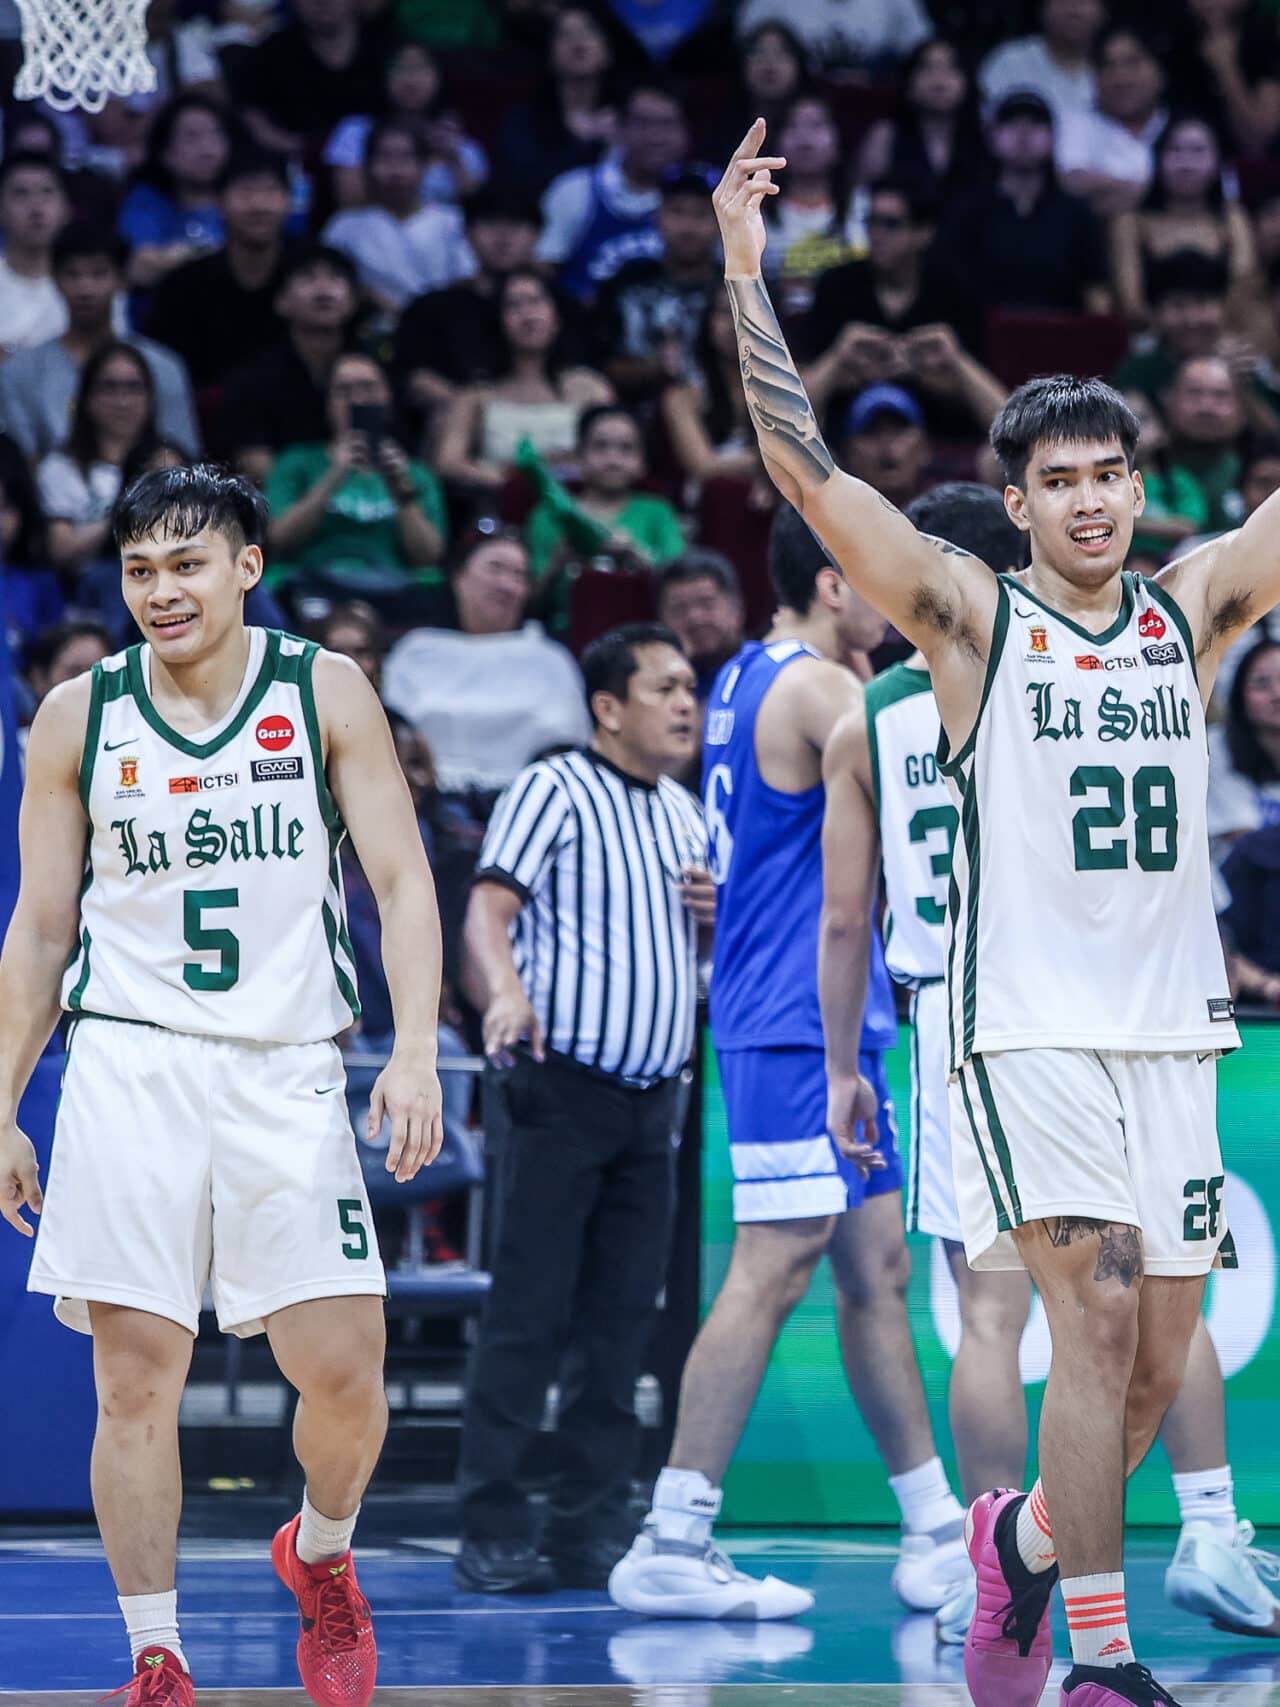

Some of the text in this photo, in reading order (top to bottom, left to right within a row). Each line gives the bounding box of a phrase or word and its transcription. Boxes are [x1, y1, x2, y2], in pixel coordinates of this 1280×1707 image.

[257, 728, 292, 740] Gazz
[1026, 682, 1191, 742] La Salle
[199, 773, 238, 790] ICTSI
[110, 802, 305, 878] La Salle
[1069, 765, 1178, 872] 28
[182, 888, 240, 992] 5
[337, 1199, 369, 1260] 5
